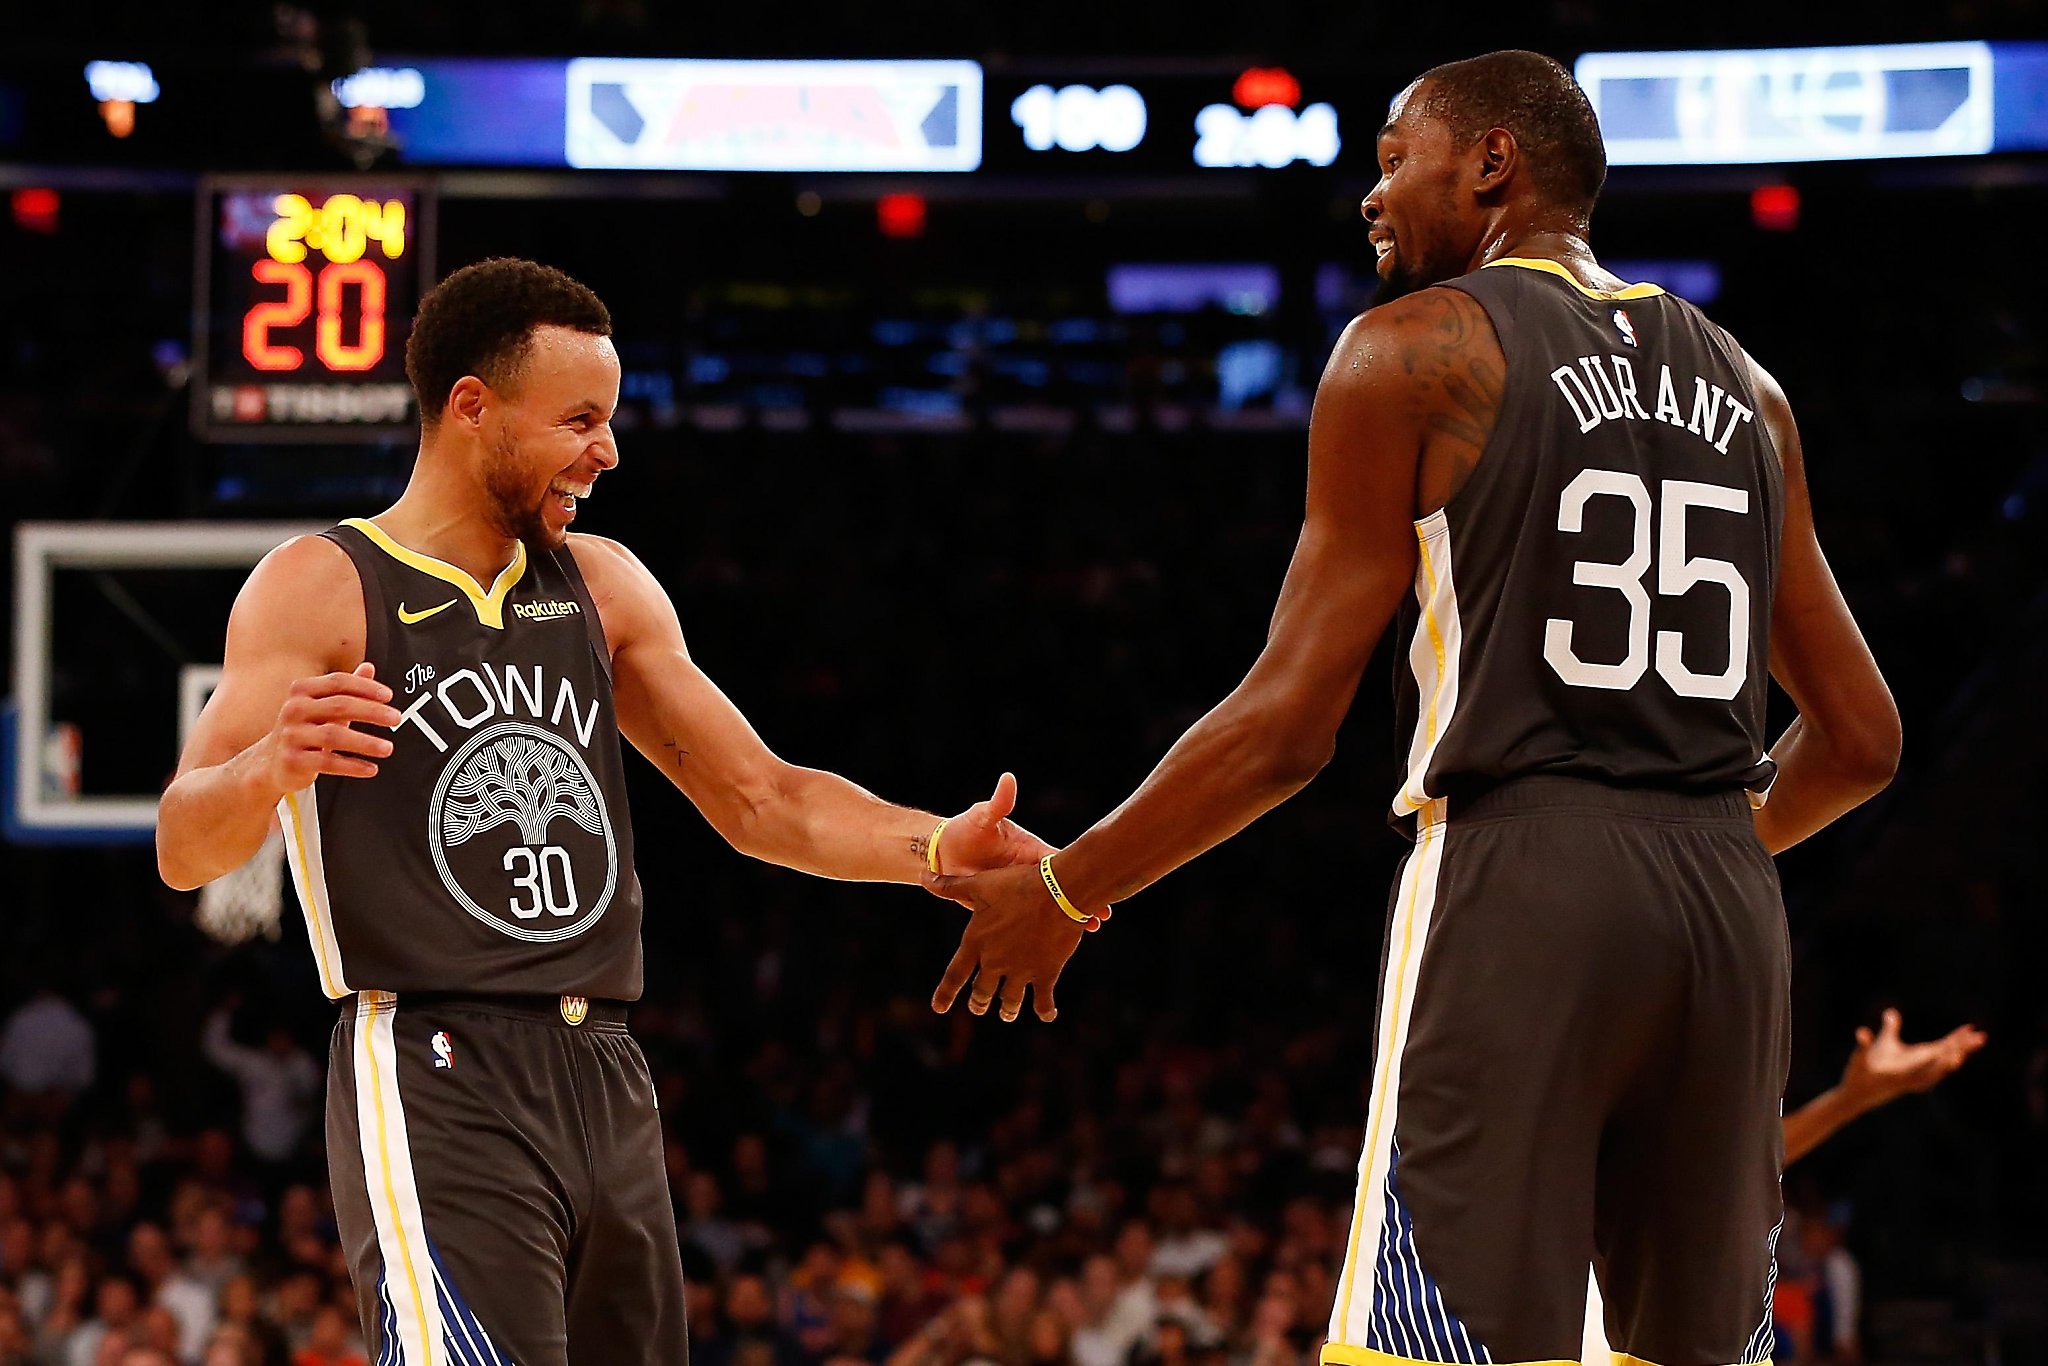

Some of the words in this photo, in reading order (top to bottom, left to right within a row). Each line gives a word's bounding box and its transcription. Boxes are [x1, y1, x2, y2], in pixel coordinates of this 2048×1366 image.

[266, 194, 405, 264] 2:04
[243, 259, 386, 370] 20
[1551, 354, 1754, 455] DURANT
[512, 599, 581, 620] Rakuten
[1543, 468, 1750, 700] 35
[389, 661, 600, 753] TOWN
[404, 663, 436, 694] The
[503, 846, 579, 919] 30
